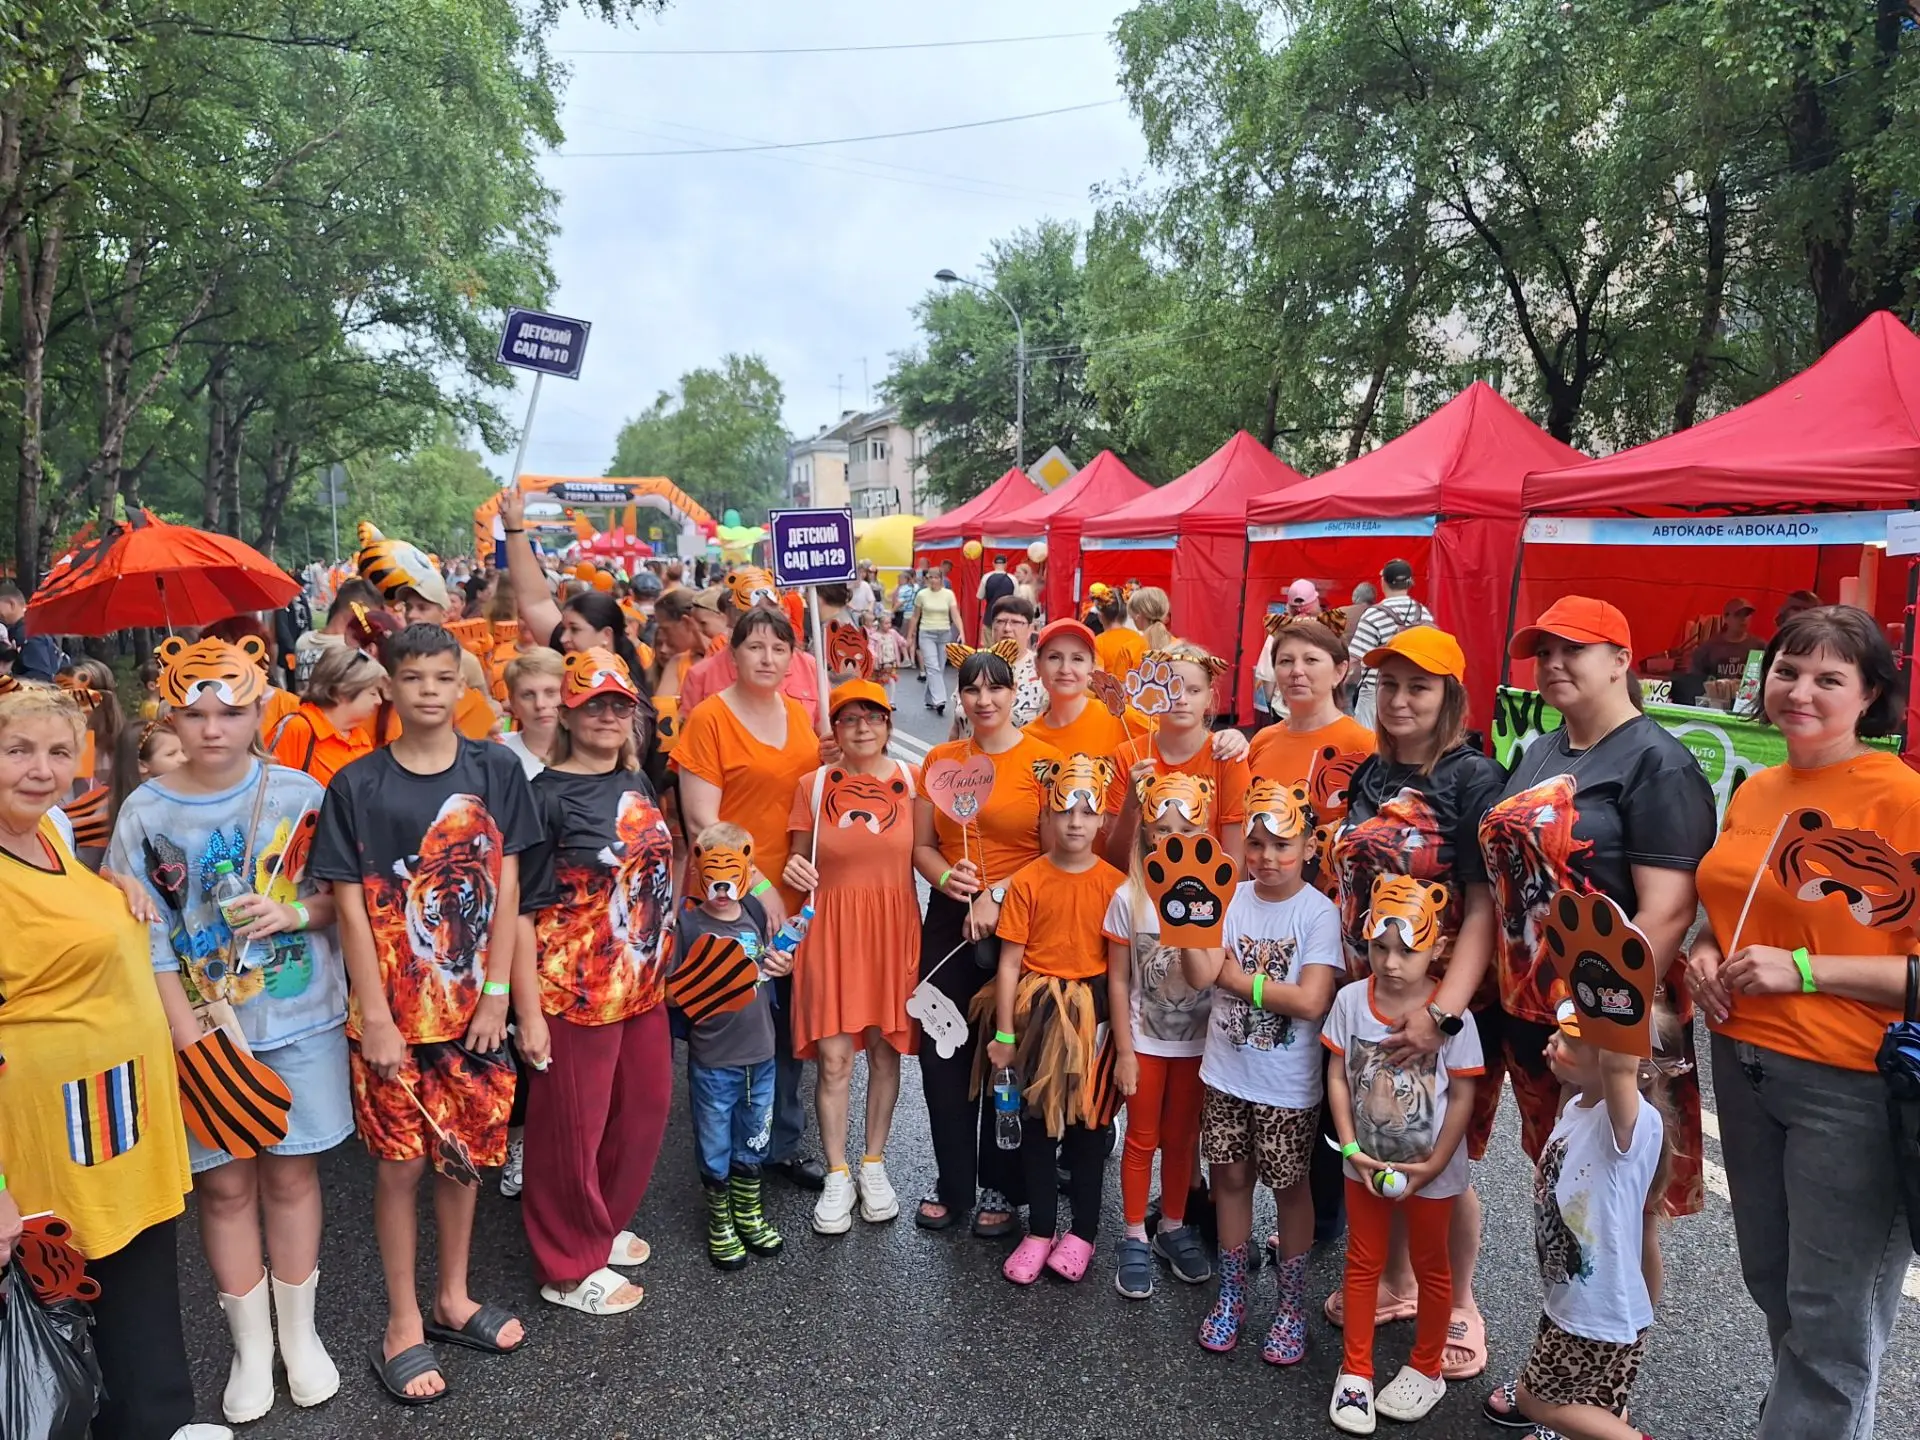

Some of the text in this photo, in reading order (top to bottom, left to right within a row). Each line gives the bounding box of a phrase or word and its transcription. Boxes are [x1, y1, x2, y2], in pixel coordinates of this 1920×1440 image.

[518, 322, 572, 346] ДЕТСКИЙ
[512, 340, 569, 364] САД №10
[788, 523, 839, 548] ДЕТСКИЙ
[1652, 522, 1819, 538] АВТОКАФЕ «АВОКАДО»
[783, 548, 846, 571] САД №129
[932, 768, 994, 791] Люблю
